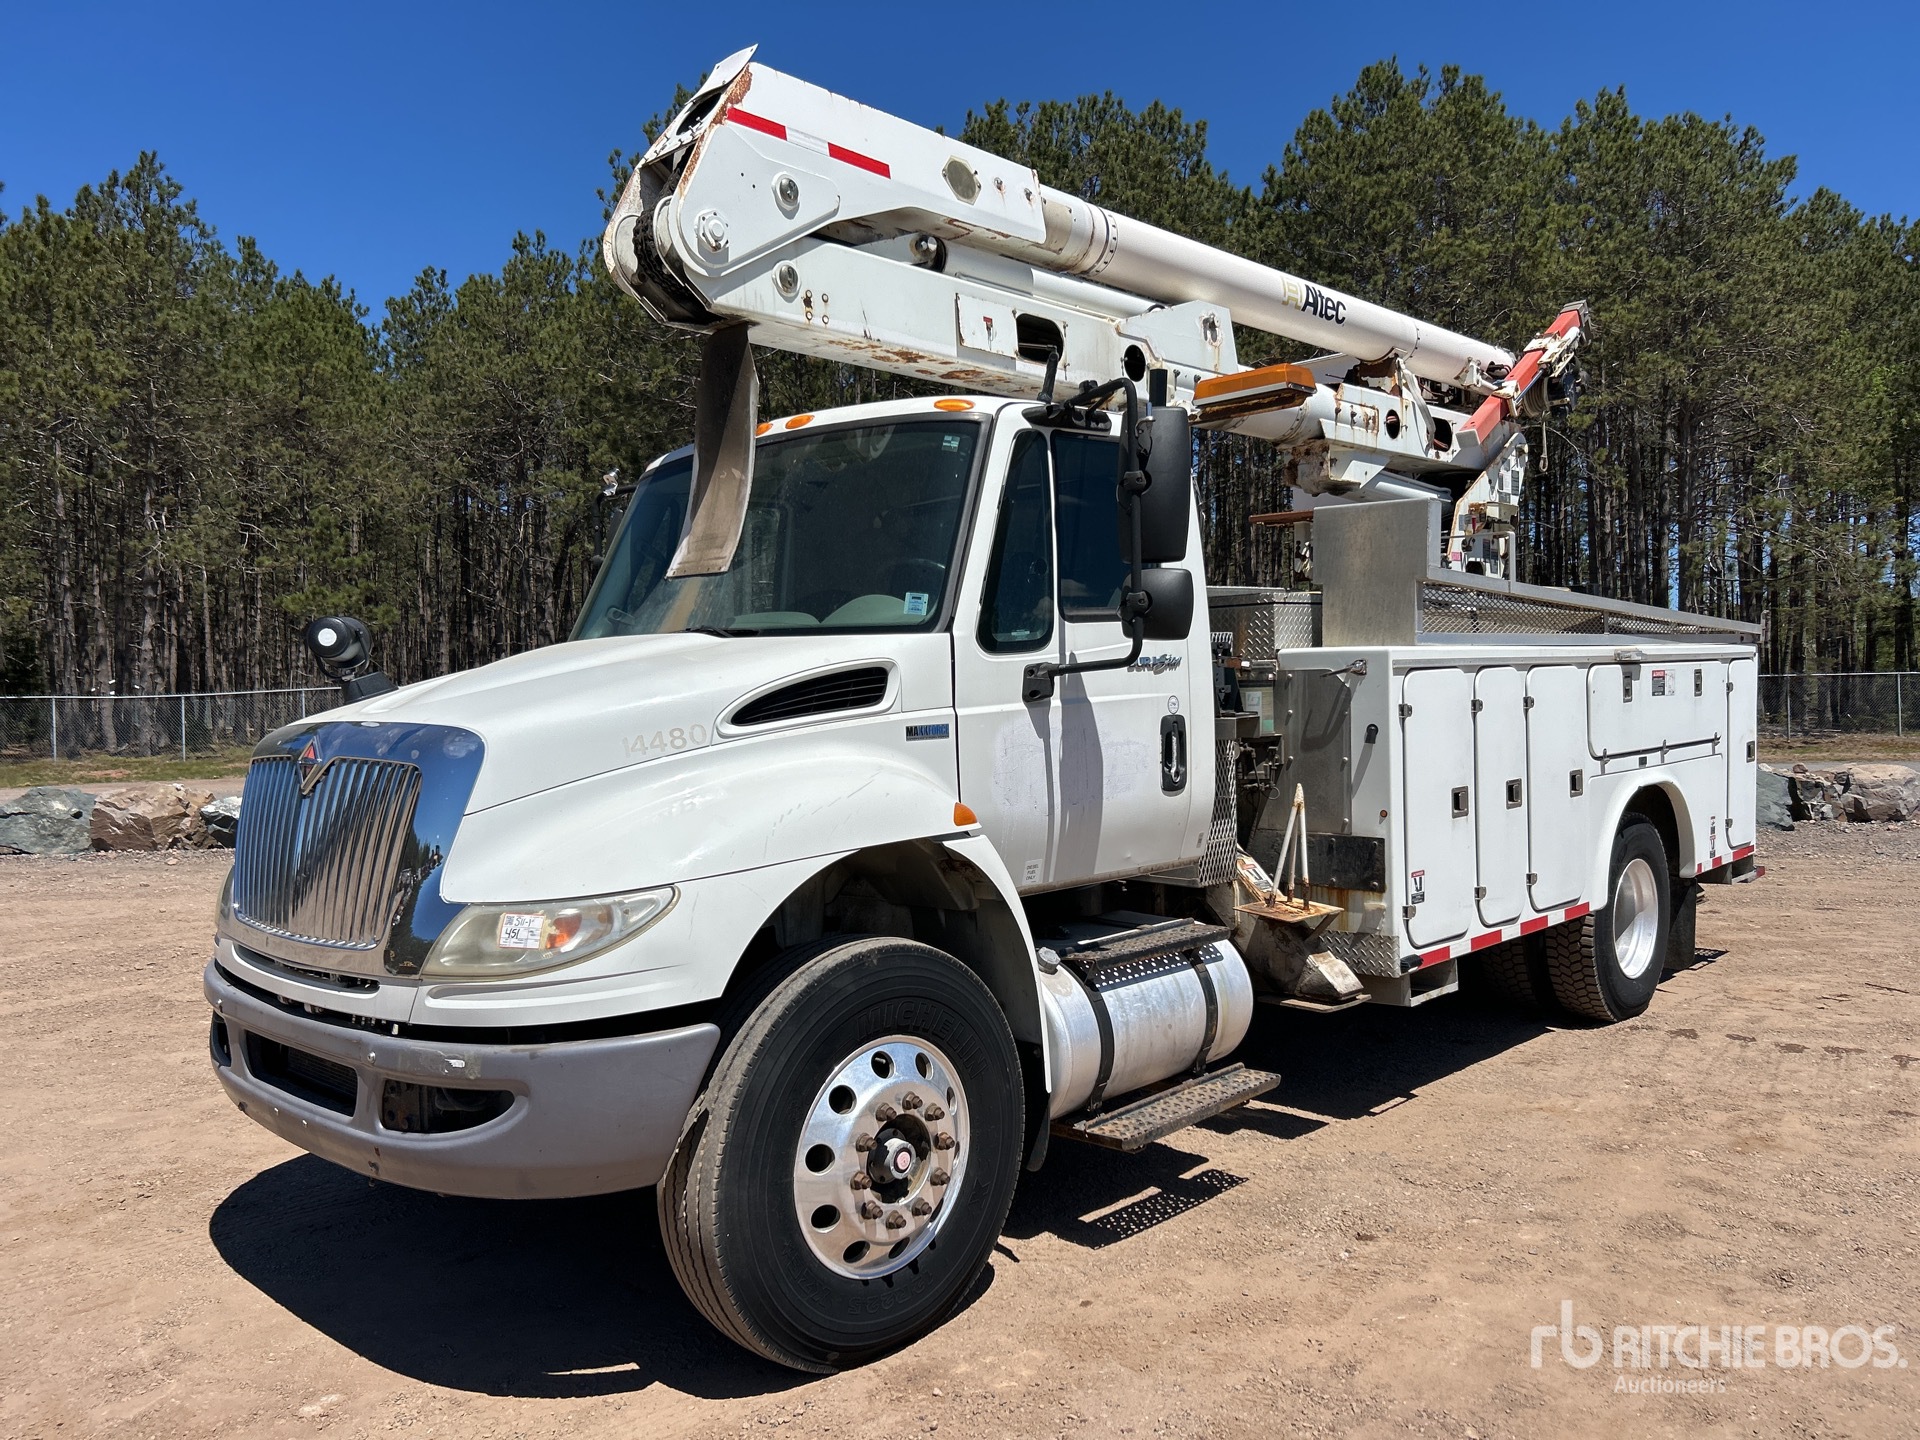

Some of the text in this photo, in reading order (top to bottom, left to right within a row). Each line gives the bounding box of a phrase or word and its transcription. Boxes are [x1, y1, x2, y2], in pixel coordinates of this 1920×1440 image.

[1301, 284, 1346, 324] Altec
[622, 723, 707, 758] 14480
[855, 1001, 989, 1079] MICHELIN
